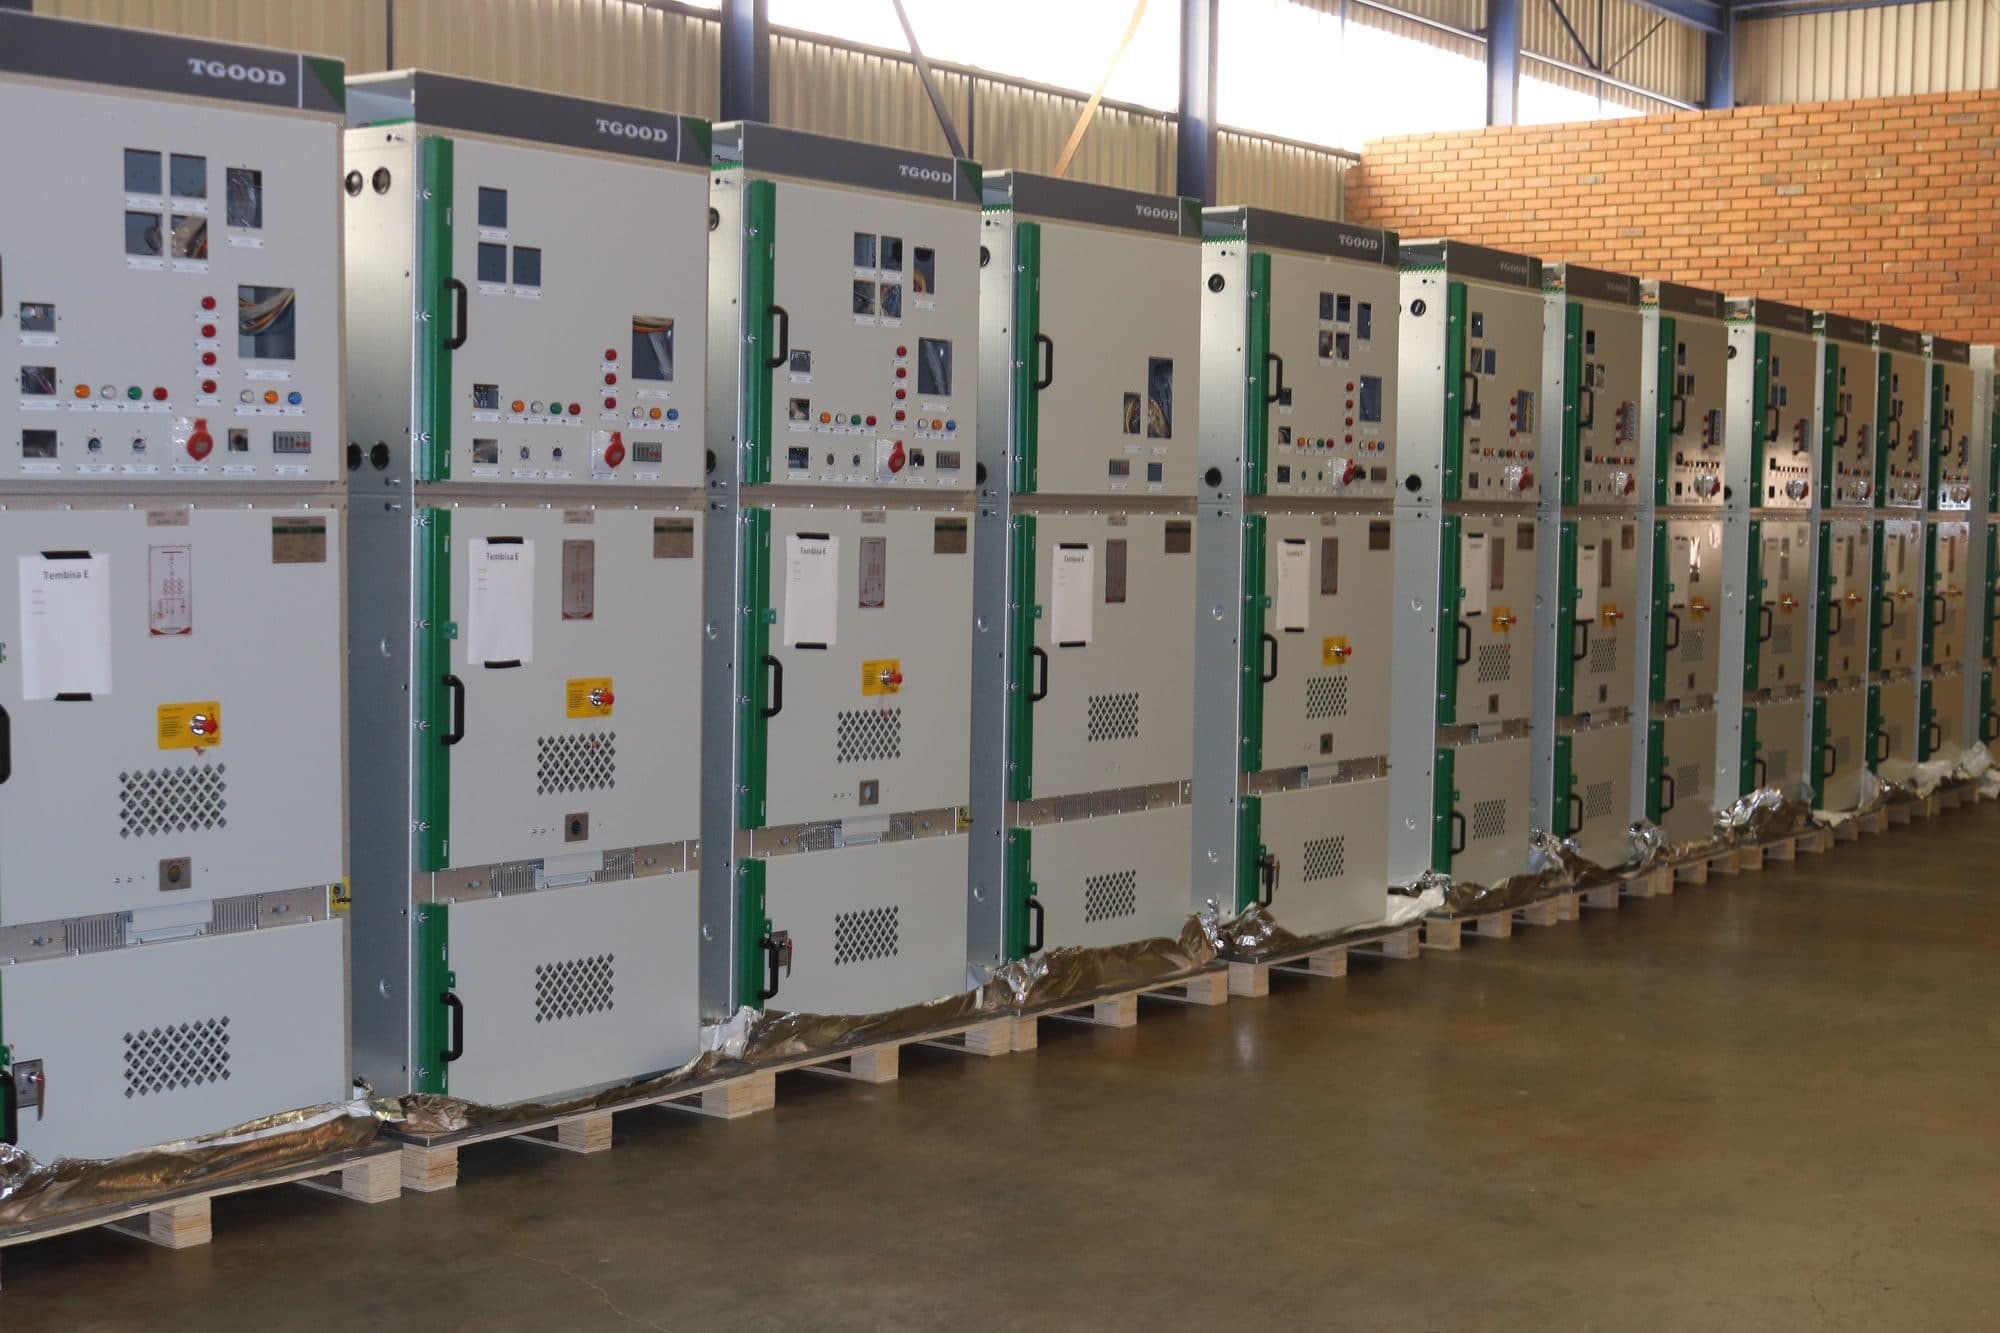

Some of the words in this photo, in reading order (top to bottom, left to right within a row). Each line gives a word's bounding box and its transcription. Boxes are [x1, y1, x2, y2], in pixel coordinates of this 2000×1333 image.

[187, 58, 286, 86] TGOOD
[595, 118, 669, 142] TGOOD
[899, 164, 953, 184] TGOOD
[1135, 204, 1178, 221] TGOOD
[1338, 234, 1378, 250] TGOOD
[42, 569, 82, 580] Tembisa
[83, 569, 89, 579] E
